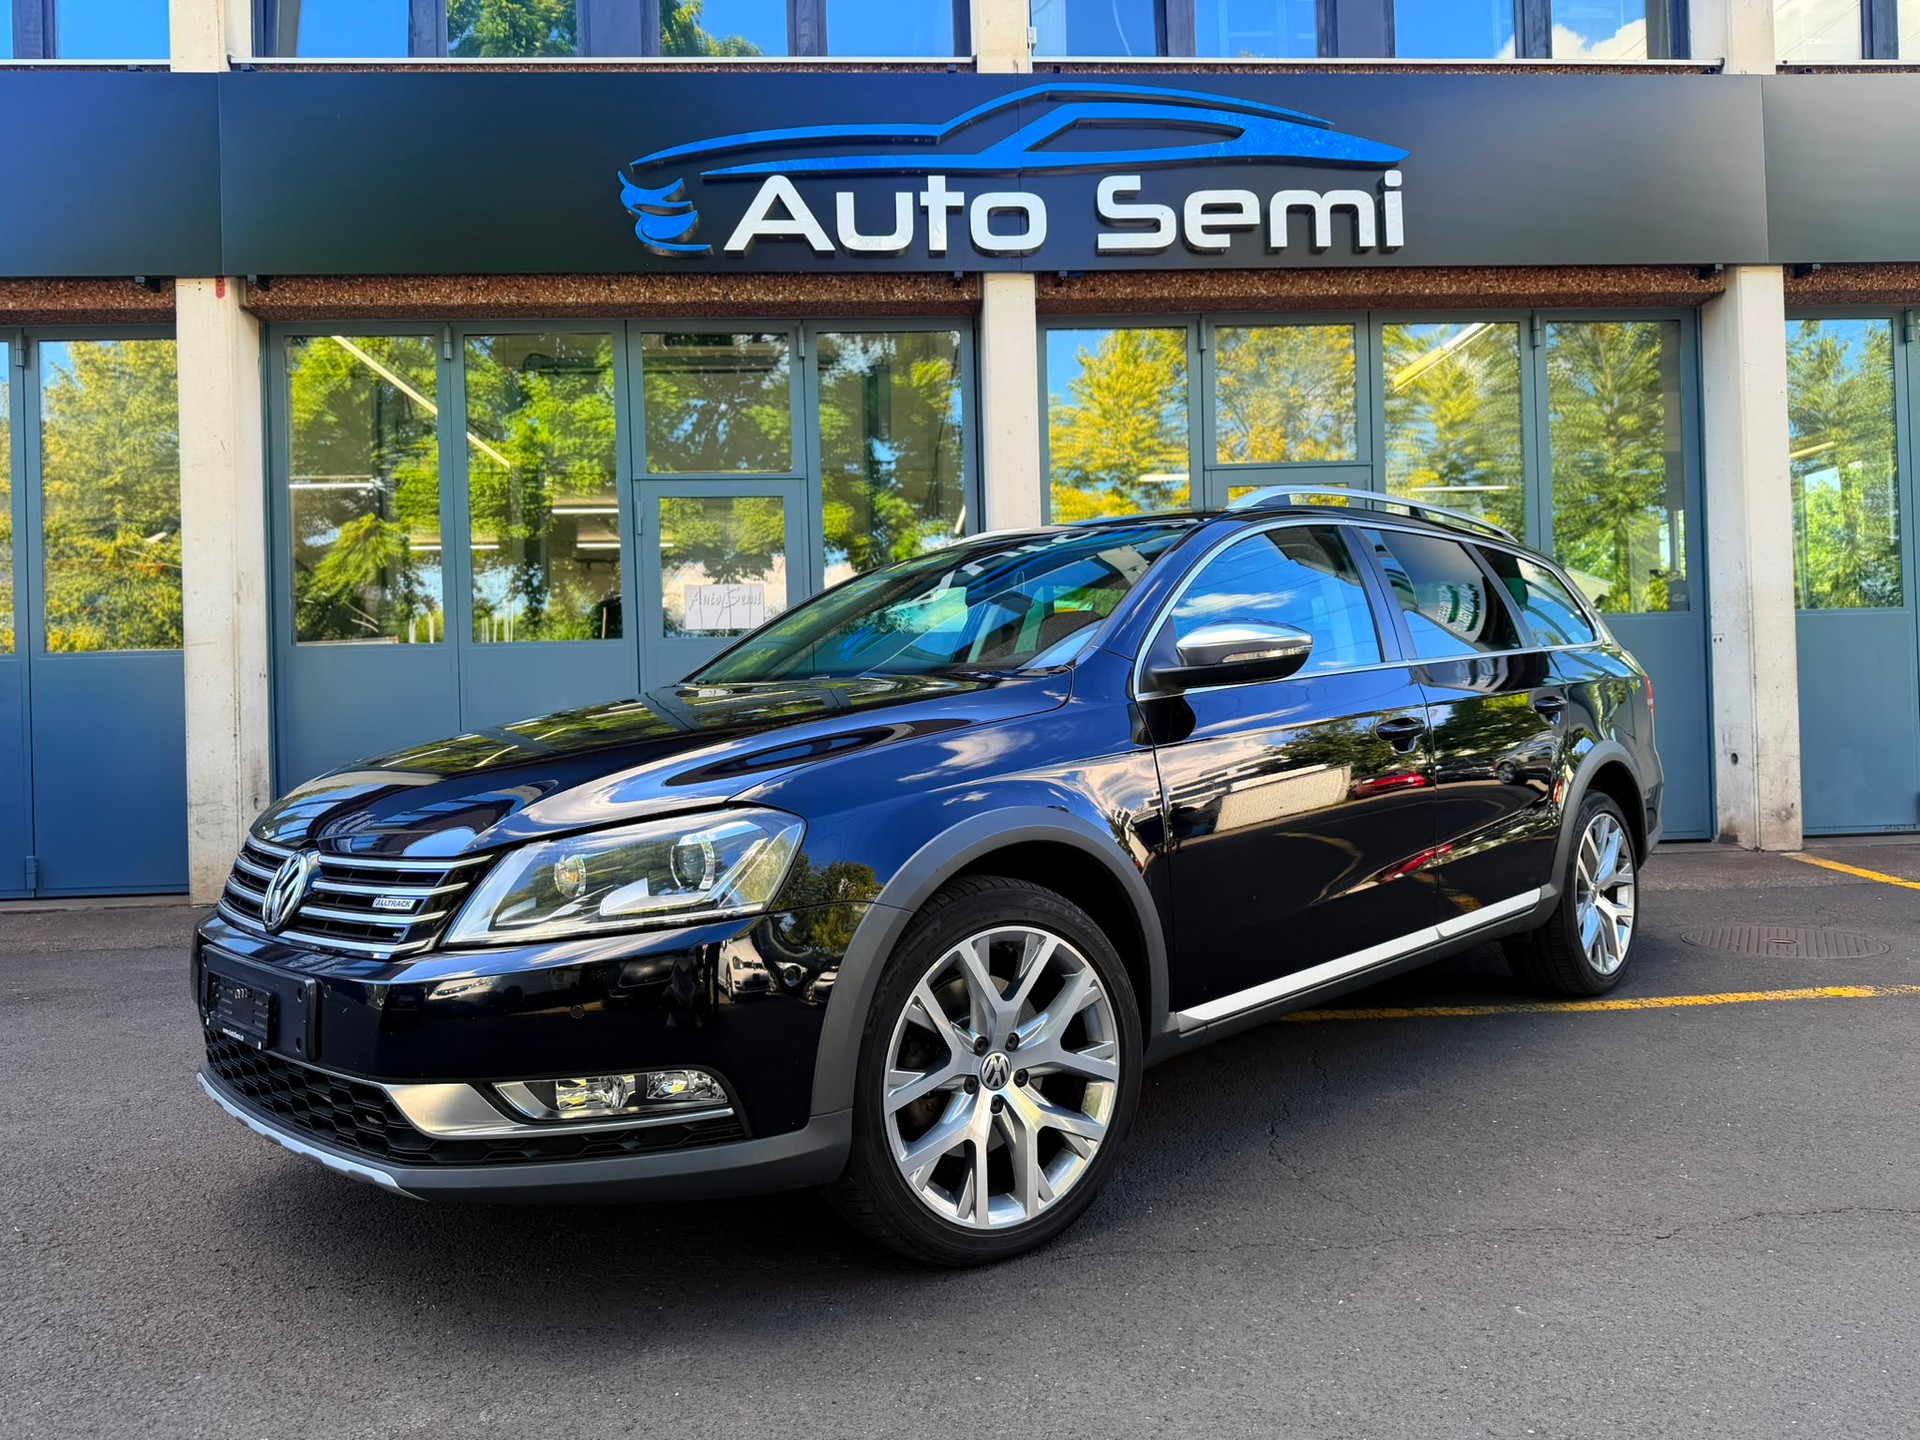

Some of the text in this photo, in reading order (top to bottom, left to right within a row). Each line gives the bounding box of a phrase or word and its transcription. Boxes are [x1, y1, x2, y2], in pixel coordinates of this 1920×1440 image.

[723, 169, 1404, 251] Auto Semi
[375, 899, 412, 908] ALLTRACK
